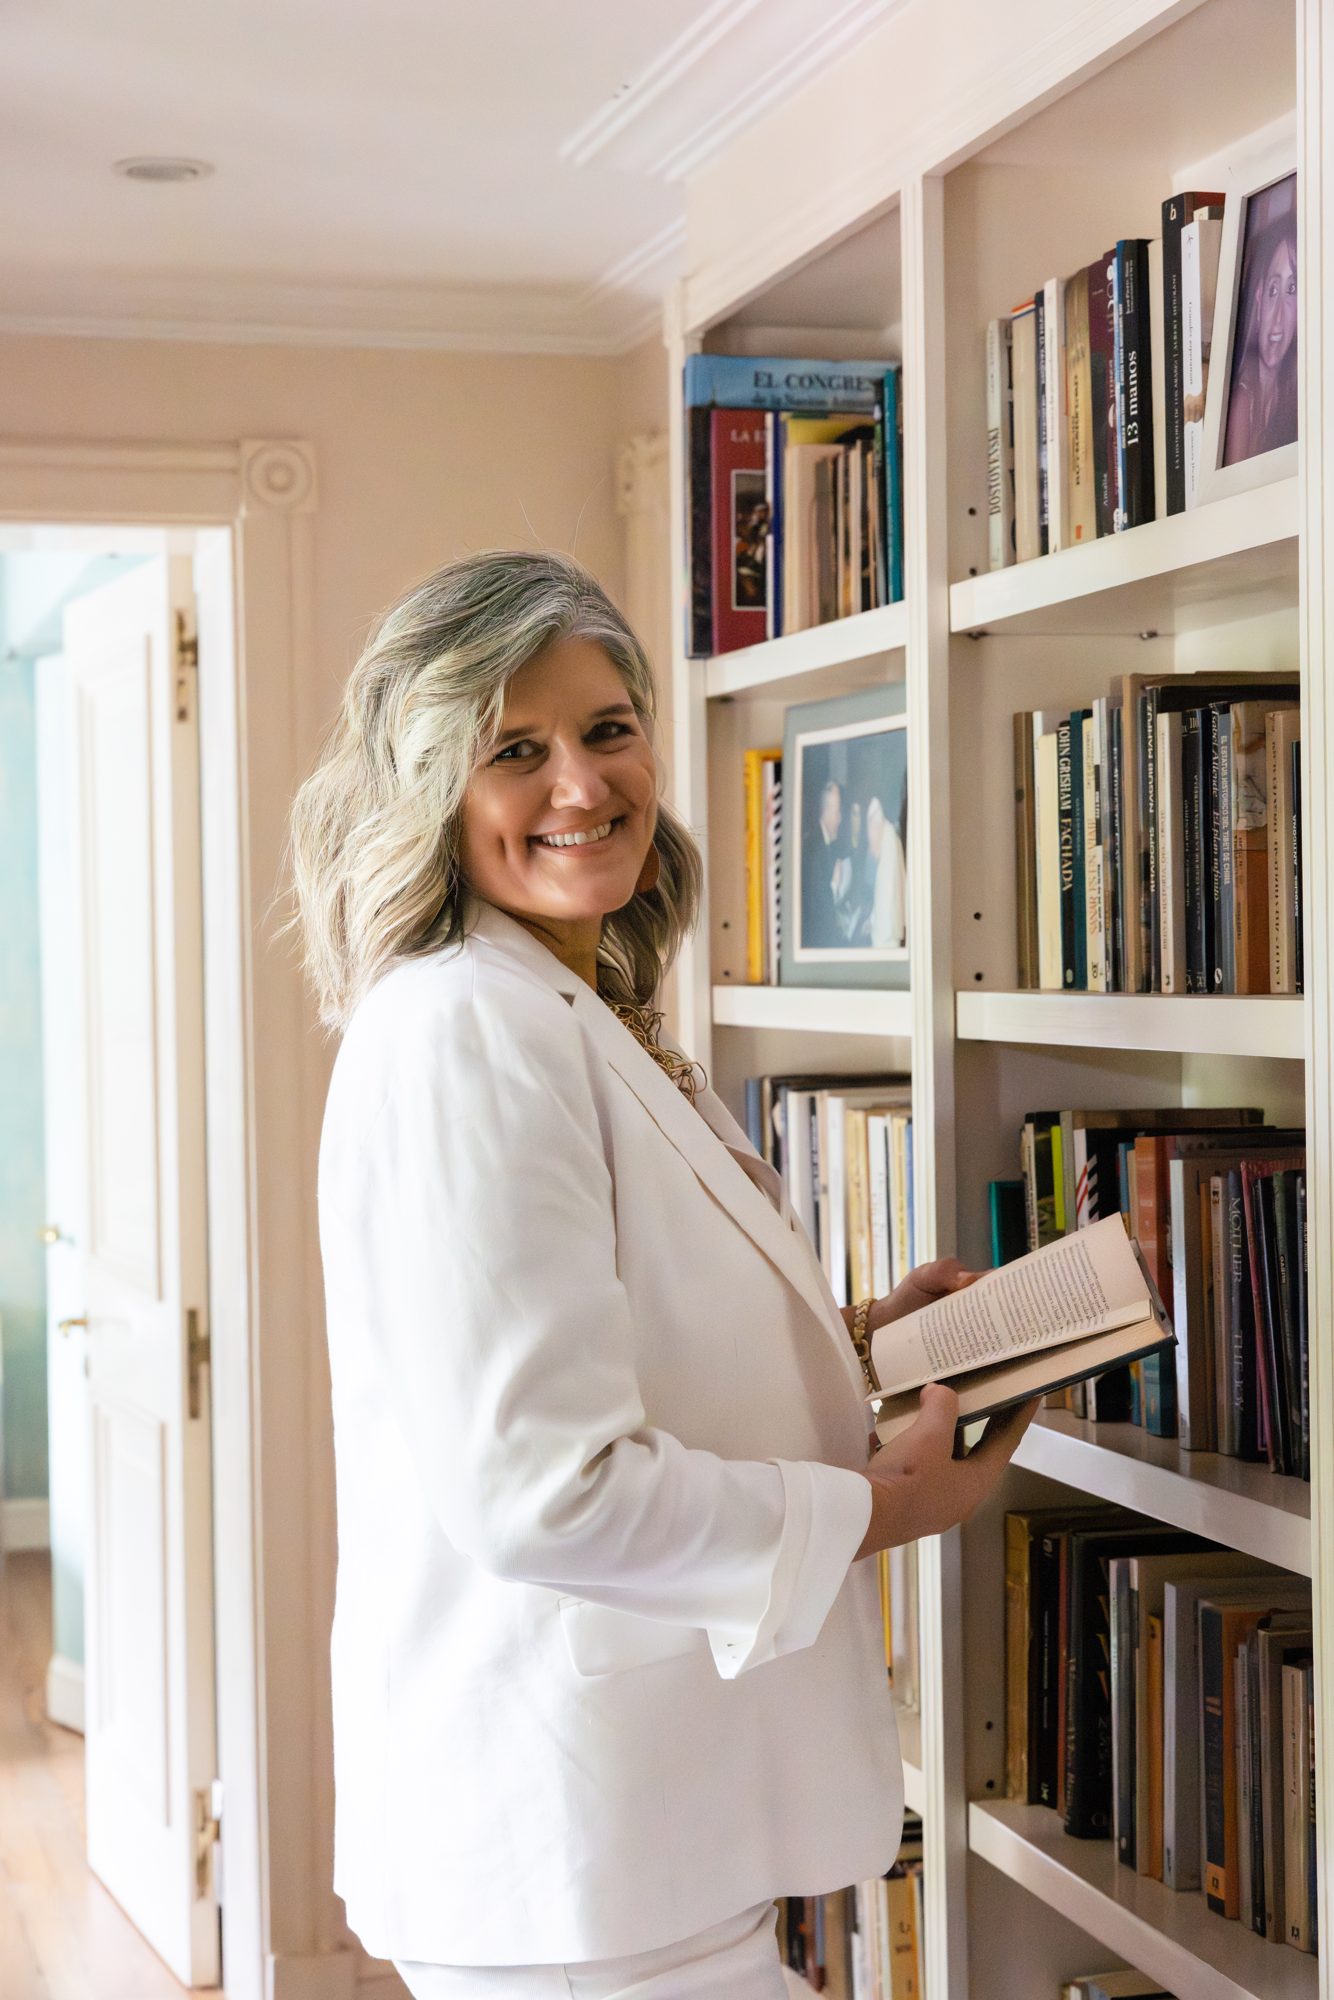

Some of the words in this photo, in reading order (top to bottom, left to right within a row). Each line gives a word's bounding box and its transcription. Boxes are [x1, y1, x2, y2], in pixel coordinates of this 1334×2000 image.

[754, 370, 778, 388] EL
[1127, 350, 1138, 416] manos
[1127, 422, 1139, 446] 13
[989, 427, 1001, 516] DOSTOYEVSKI
[1059, 725, 1071, 756] JOHN
[1211, 710, 1219, 746] Isabel
[1059, 757, 1072, 811] GRISHAM
[1060, 817, 1073, 892] FACHADA
